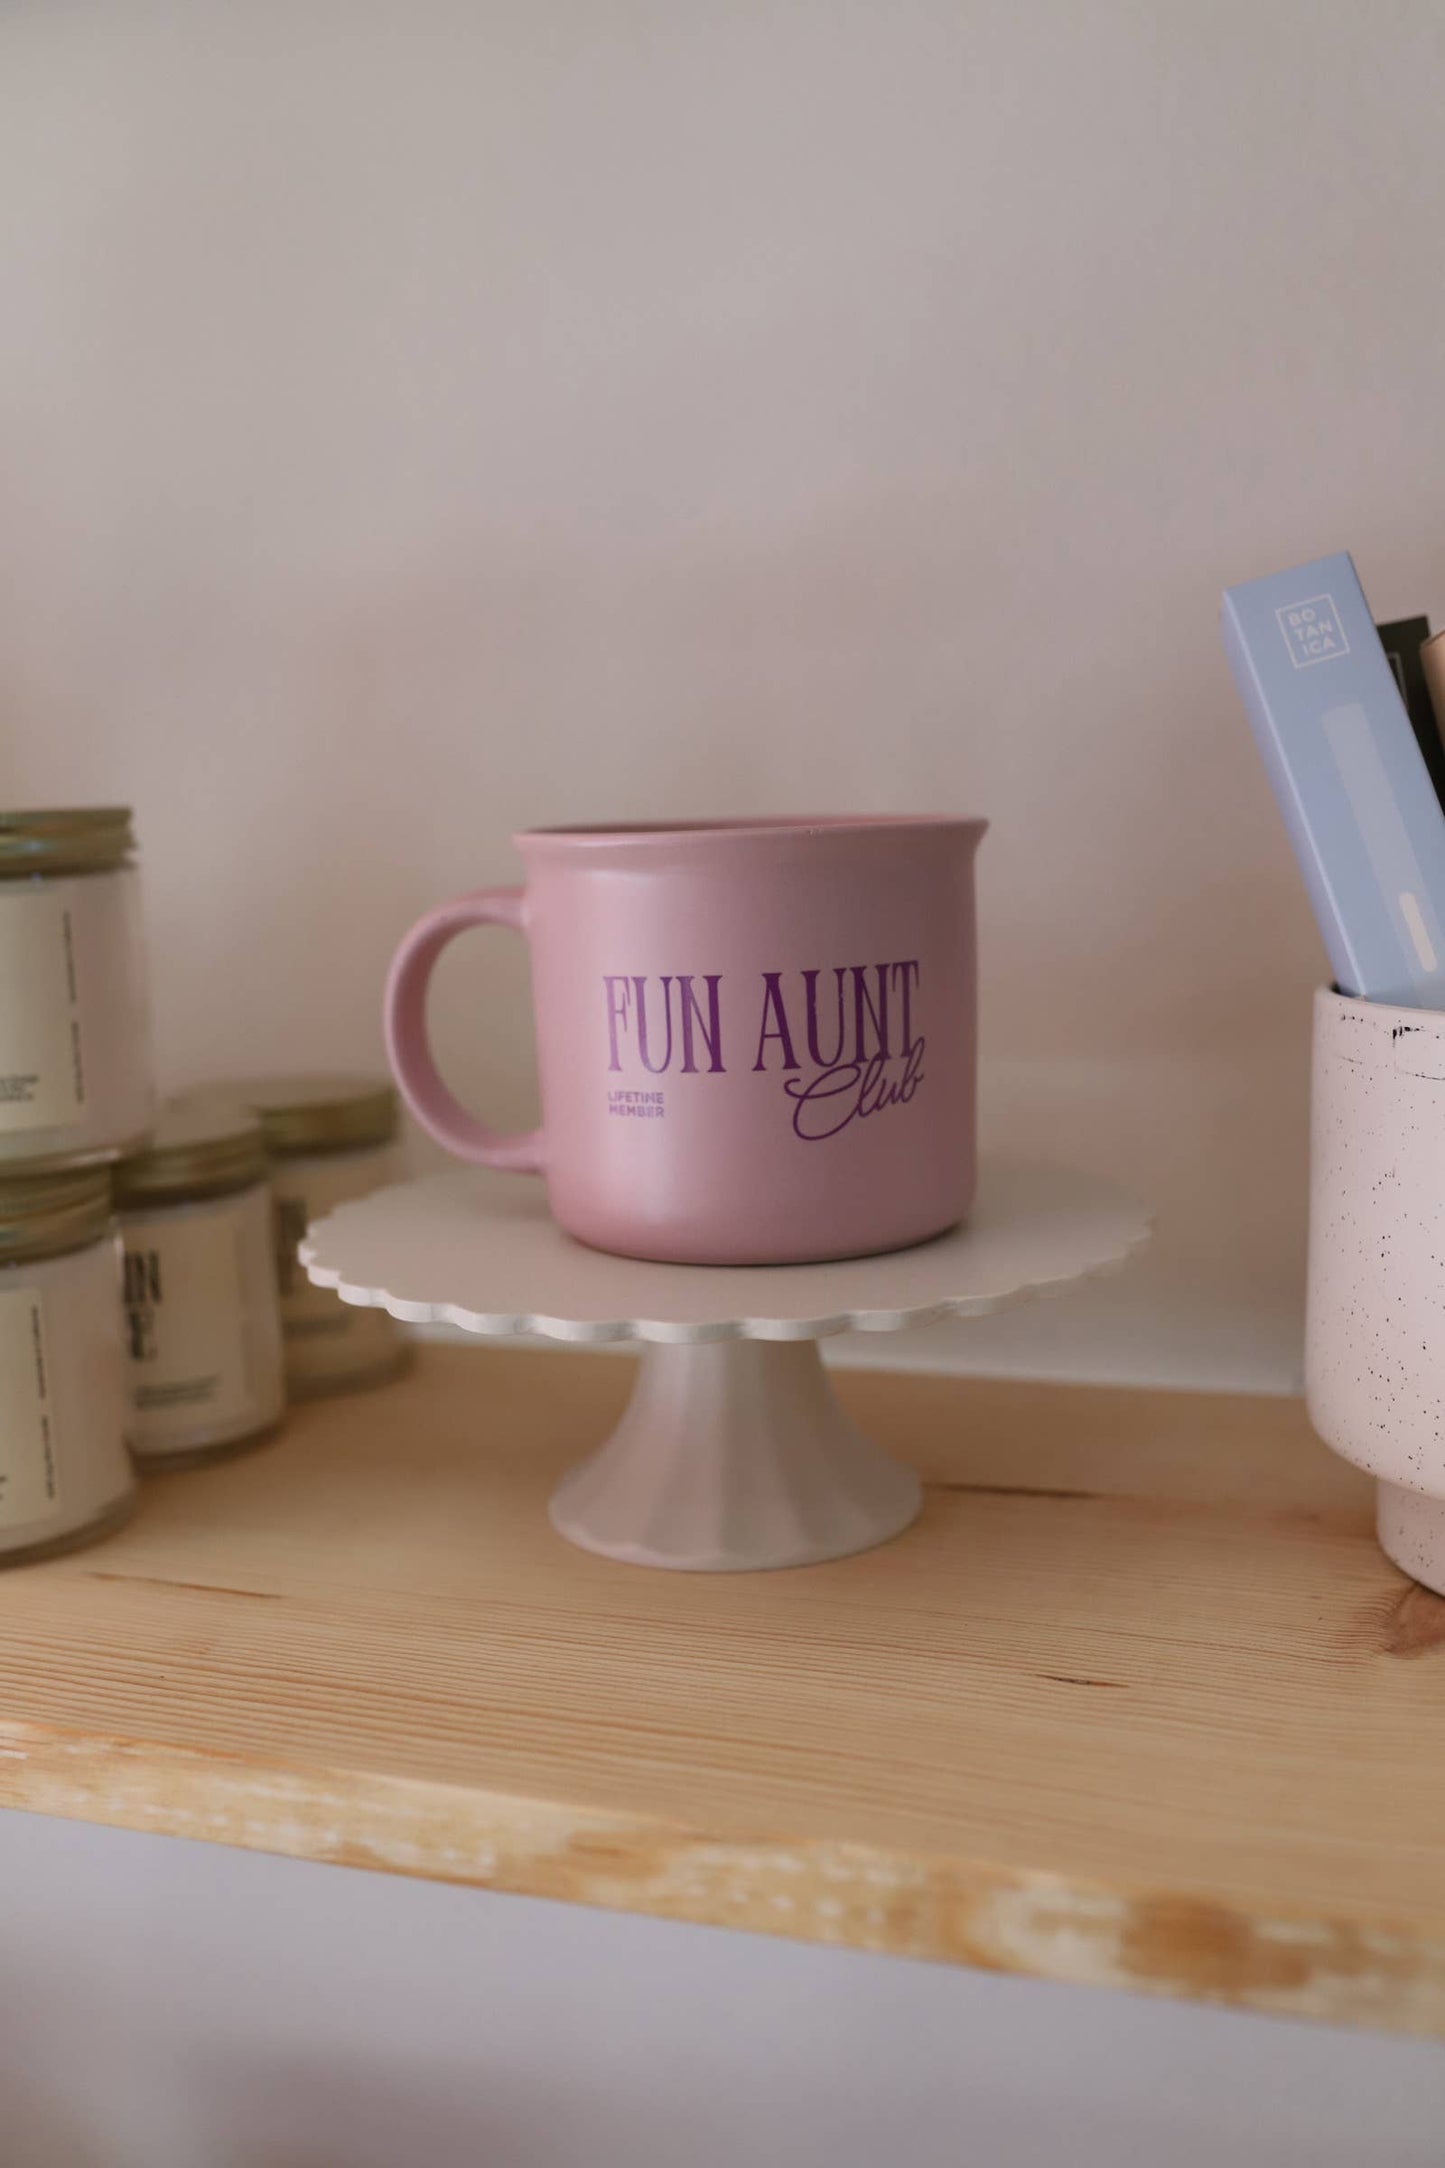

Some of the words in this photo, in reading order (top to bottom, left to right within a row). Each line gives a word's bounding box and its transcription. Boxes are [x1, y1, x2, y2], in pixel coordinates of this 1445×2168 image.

[603, 975, 727, 1074] FUN
[752, 960, 920, 1070] AUNT
[608, 1091, 664, 1104] LIFETIME
[609, 1104, 664, 1118] MEMBER
[784, 1037, 925, 1141] Club
